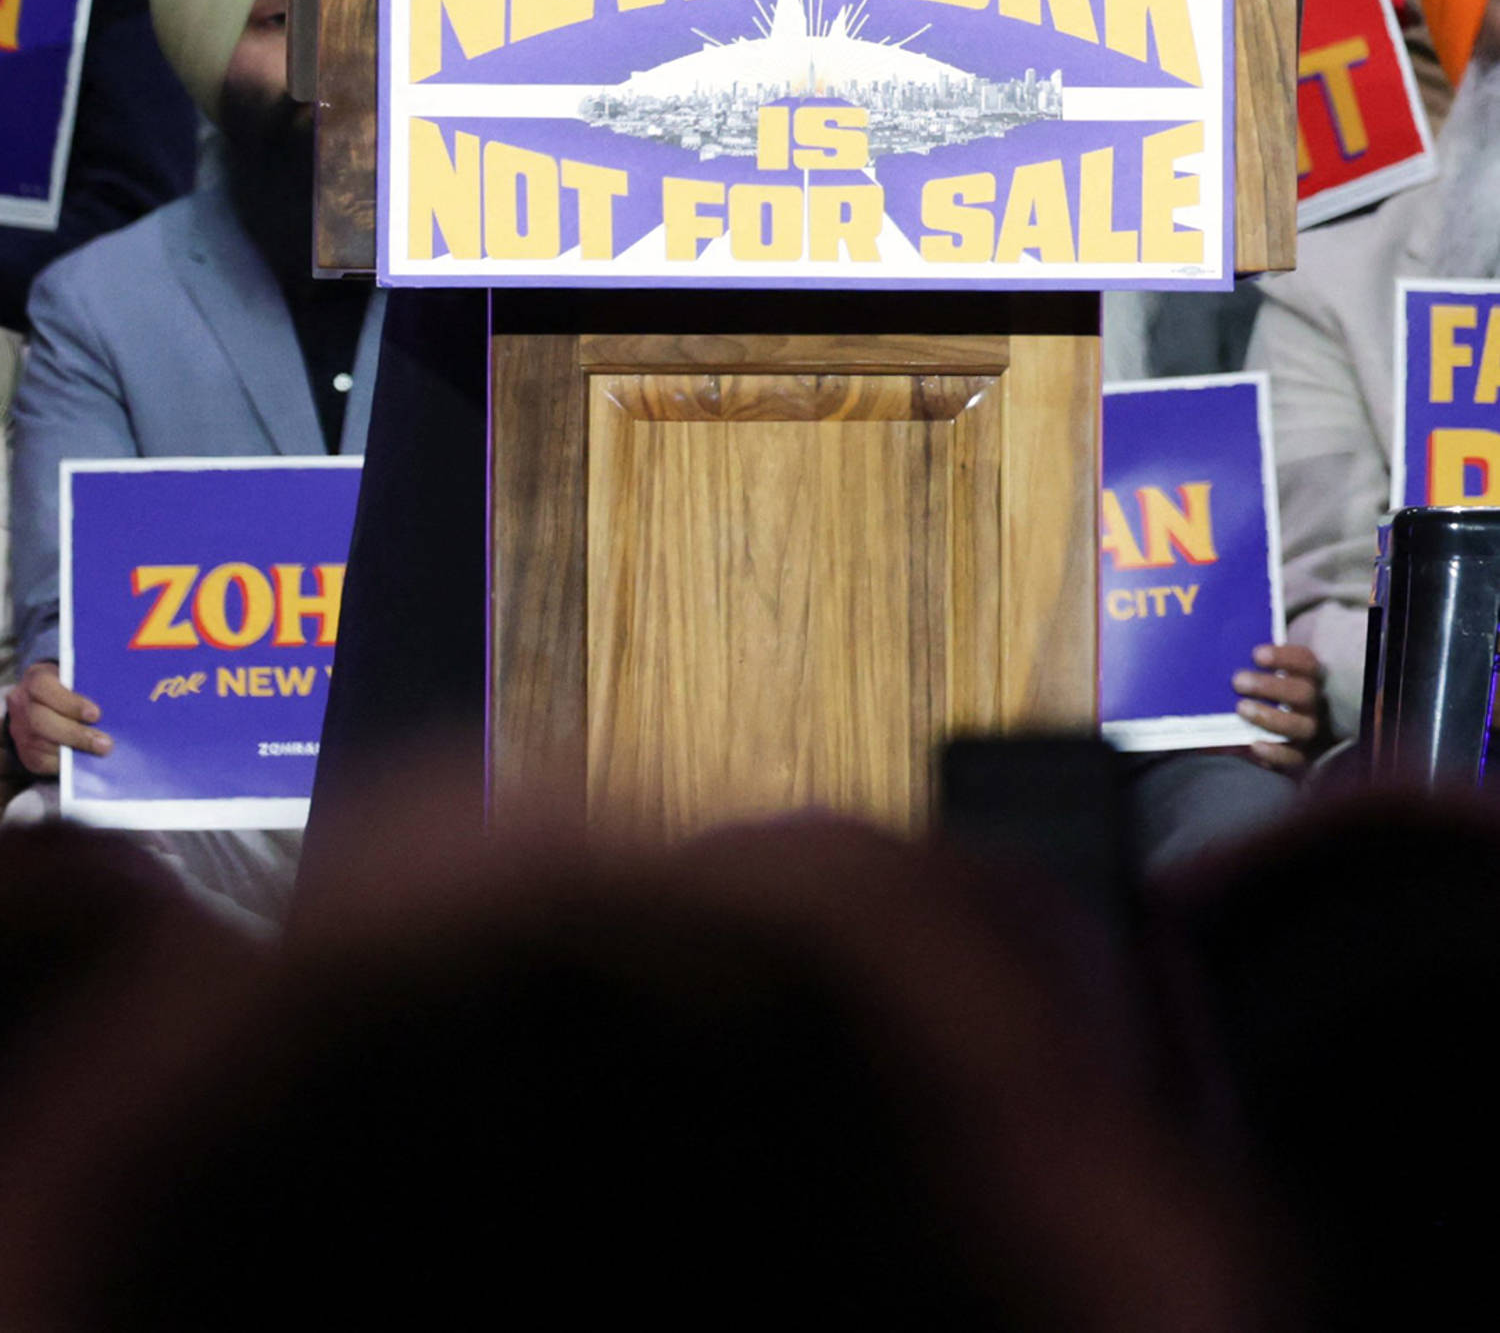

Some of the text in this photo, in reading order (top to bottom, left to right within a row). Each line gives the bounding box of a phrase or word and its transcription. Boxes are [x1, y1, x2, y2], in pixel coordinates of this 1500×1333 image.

[757, 106, 870, 171] IS
[407, 116, 1205, 265] NOT FOR SALE
[127, 561, 348, 651] ZOH
[1106, 584, 1200, 621] CITY
[216, 666, 317, 698] NEW
